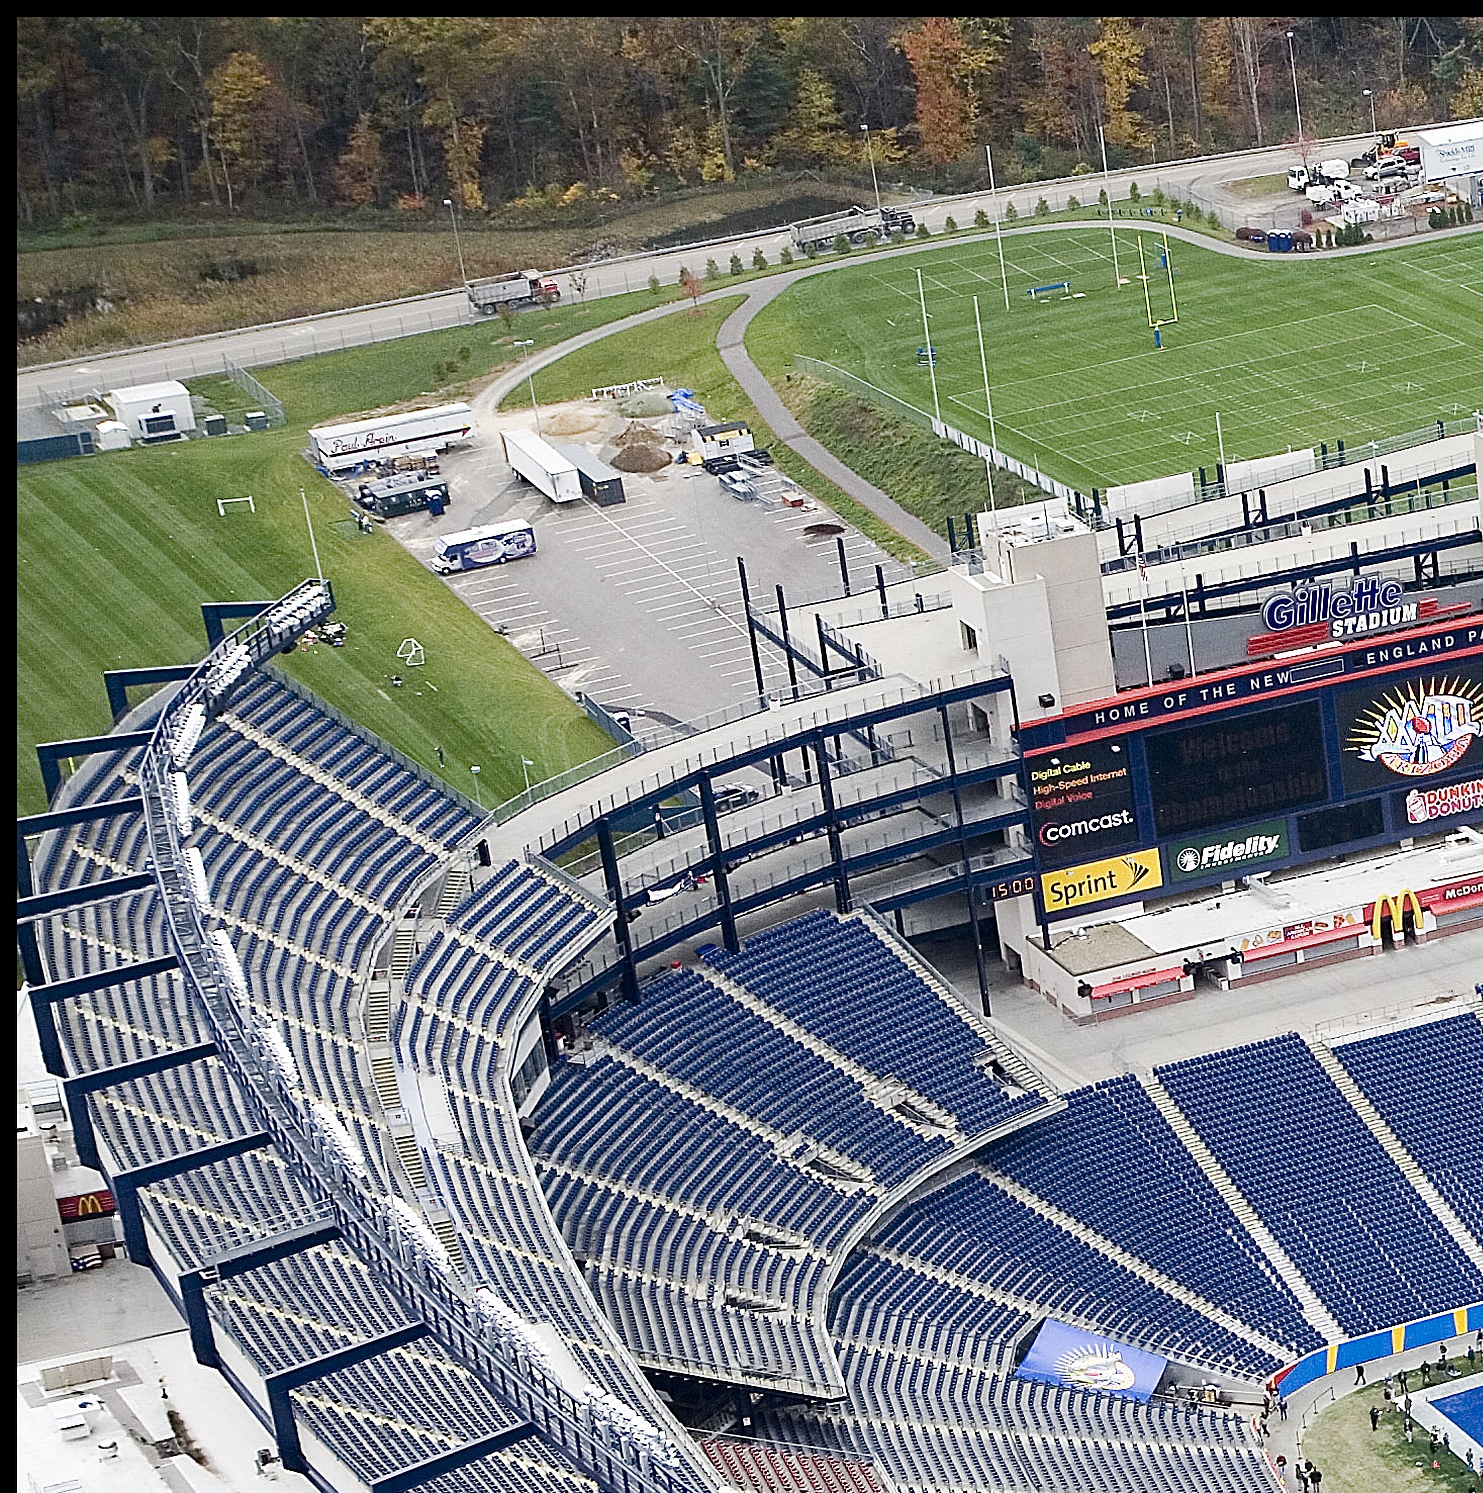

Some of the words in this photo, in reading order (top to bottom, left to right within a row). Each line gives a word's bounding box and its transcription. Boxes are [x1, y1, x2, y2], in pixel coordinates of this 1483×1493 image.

[1263, 575, 1402, 631] Gillette
[1332, 603, 1418, 638] STADIUM
[1095, 702, 1149, 725] HOME
[1164, 693, 1187, 709] OF
[1200, 683, 1236, 701] THE
[1251, 670, 1290, 691] NEW
[1366, 635, 1455, 665] ENGLAND
[1031, 766, 1061, 780] Digital
[1063, 760, 1091, 775] Cable
[1033, 775, 1089, 795] High-Speed
[1090, 767, 1127, 784] Internet
[1035, 795, 1065, 809] Digital
[1201, 833, 1280, 865] Fidelity
[1050, 870, 1118, 905] Sprint
